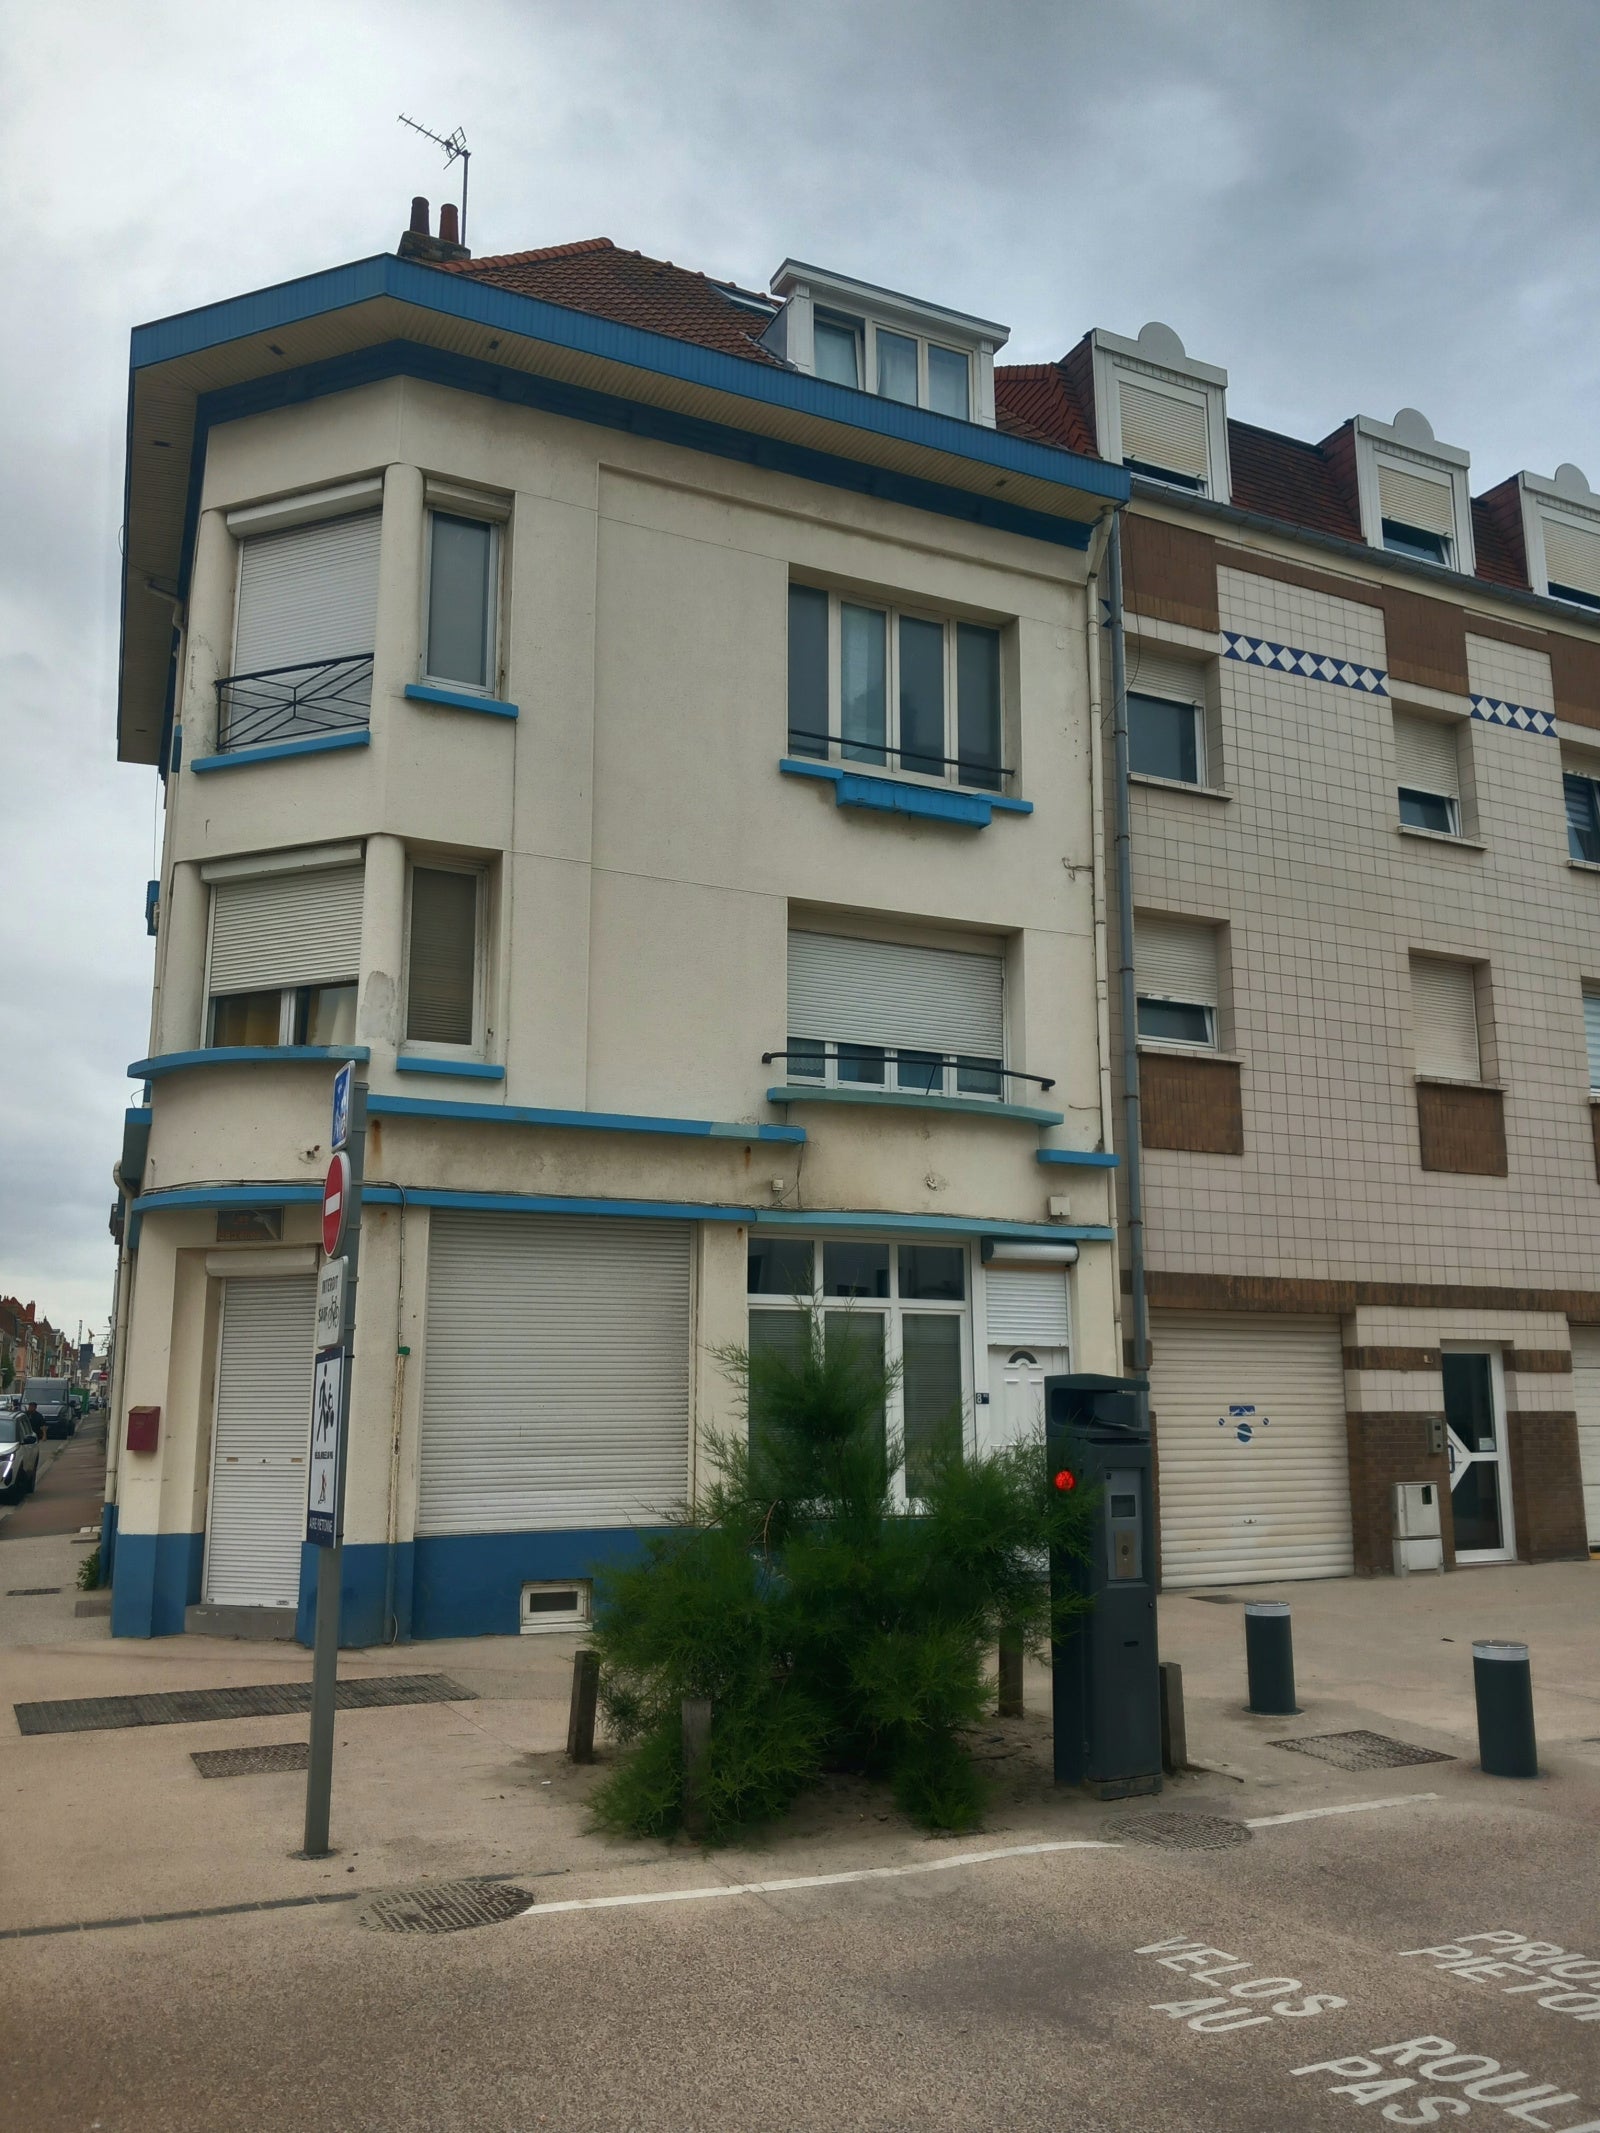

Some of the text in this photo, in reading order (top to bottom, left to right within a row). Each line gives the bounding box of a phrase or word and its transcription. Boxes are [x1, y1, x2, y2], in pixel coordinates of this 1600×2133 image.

[318, 1306, 328, 1323] SAUF
[322, 1275, 339, 1294] INTERDIT
[1399, 1944, 1600, 2021] PIETO
[1453, 1930, 1600, 1989] PRIO
[1134, 1936, 1600, 2133] VELOS ROUL
[1149, 1997, 1470, 2125] AU PAS
